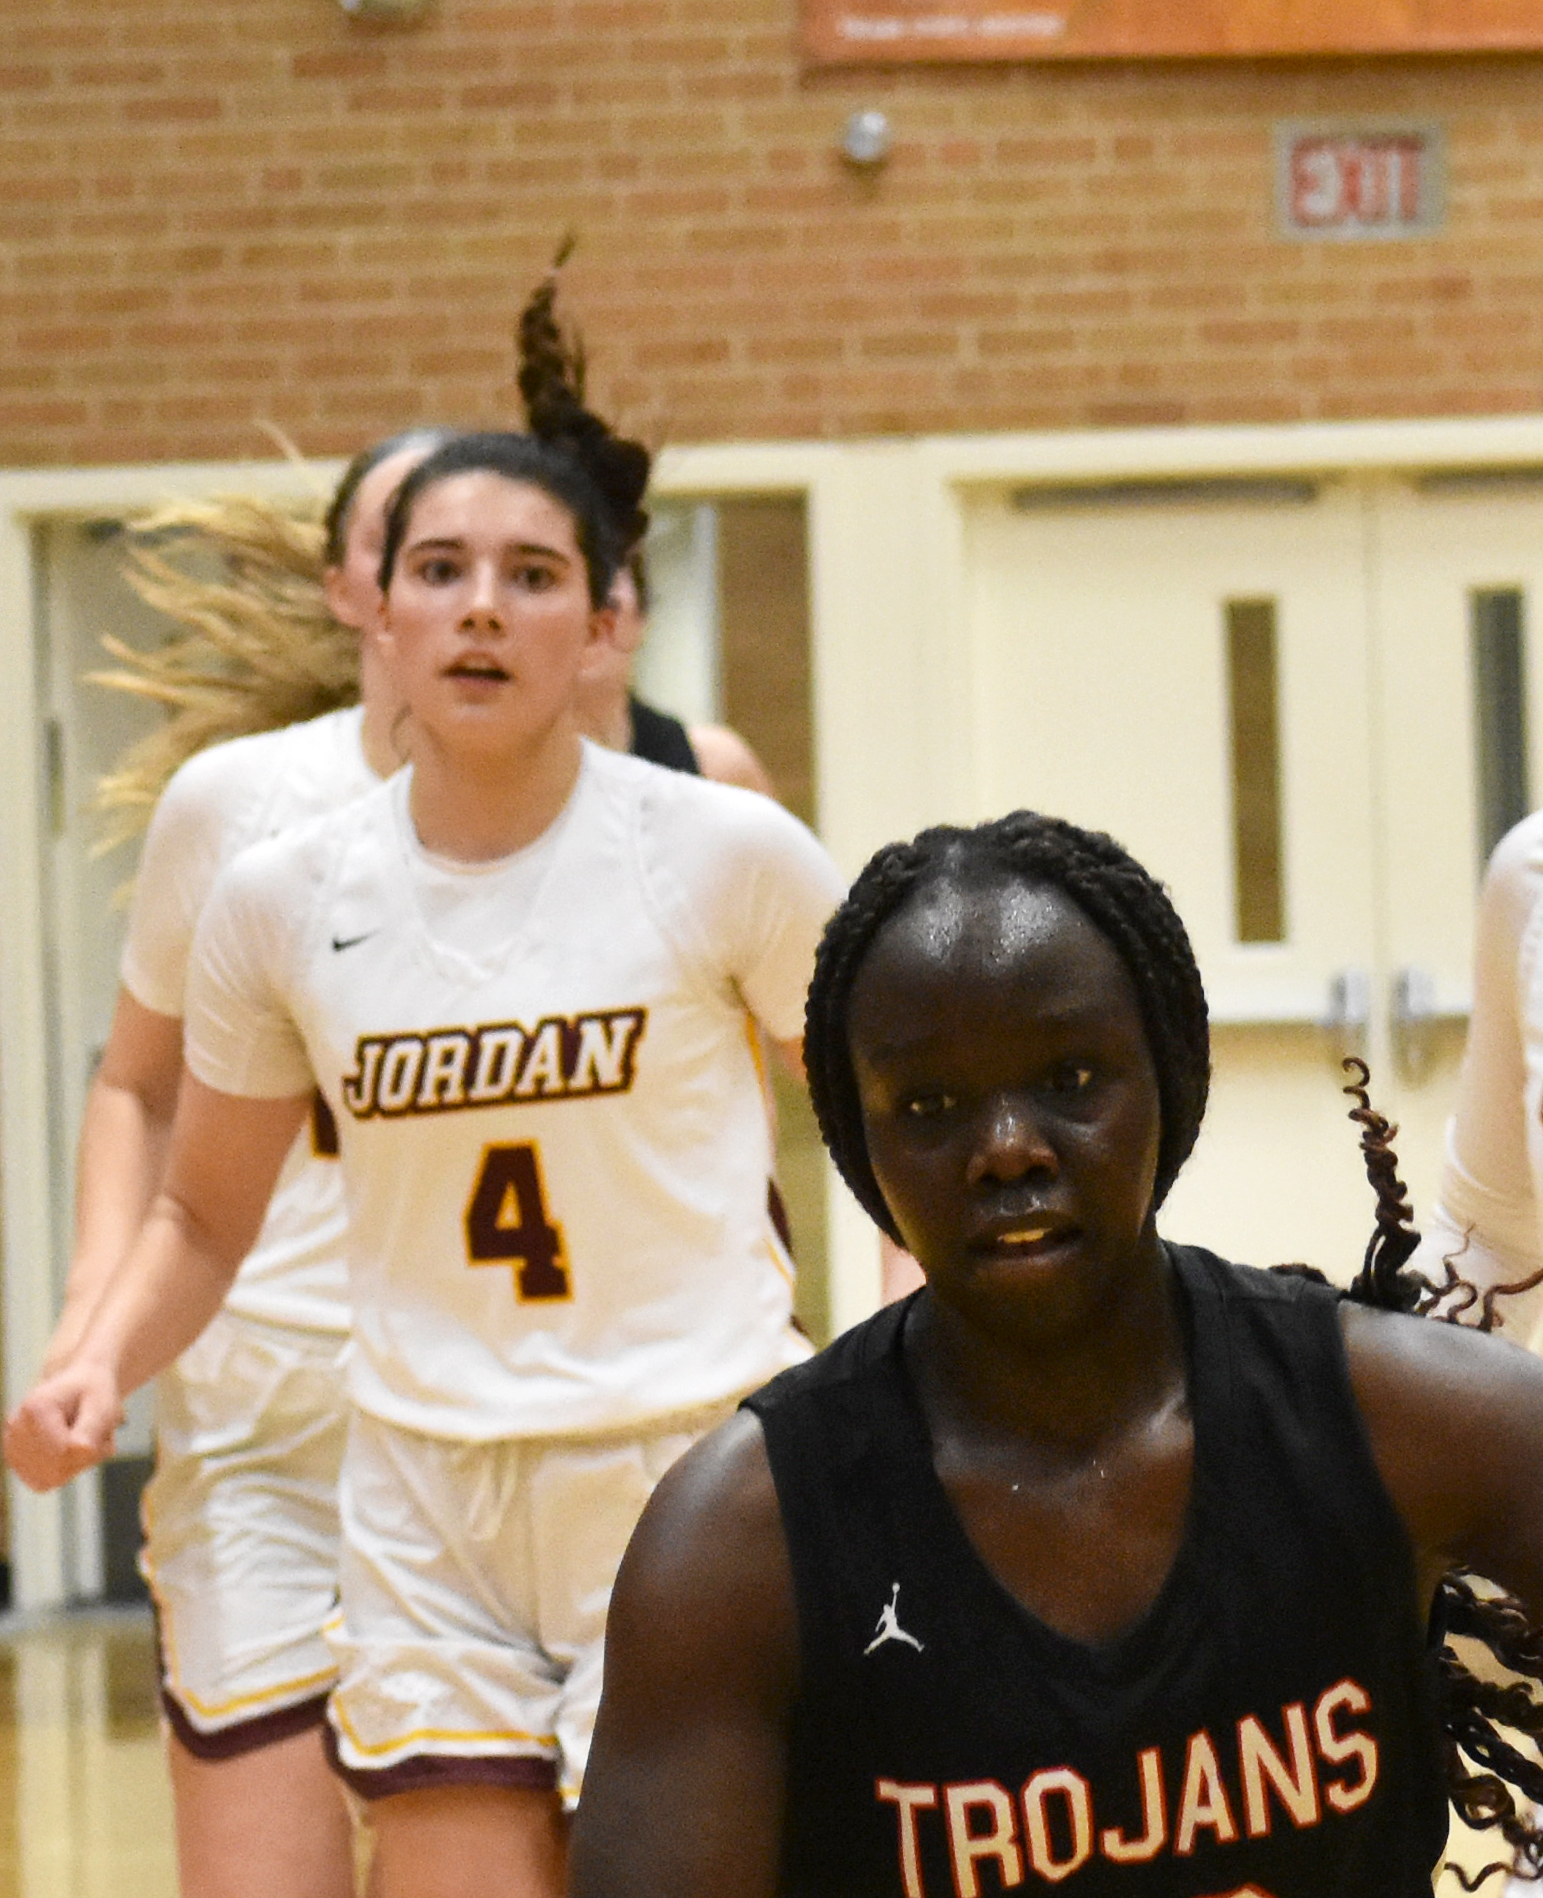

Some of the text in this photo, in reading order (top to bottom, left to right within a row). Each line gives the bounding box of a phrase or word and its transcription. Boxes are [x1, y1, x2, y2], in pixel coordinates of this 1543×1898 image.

[1289, 133, 1425, 228] EXIT
[341, 1005, 648, 1120] JORDAN
[463, 1137, 574, 1304] 4
